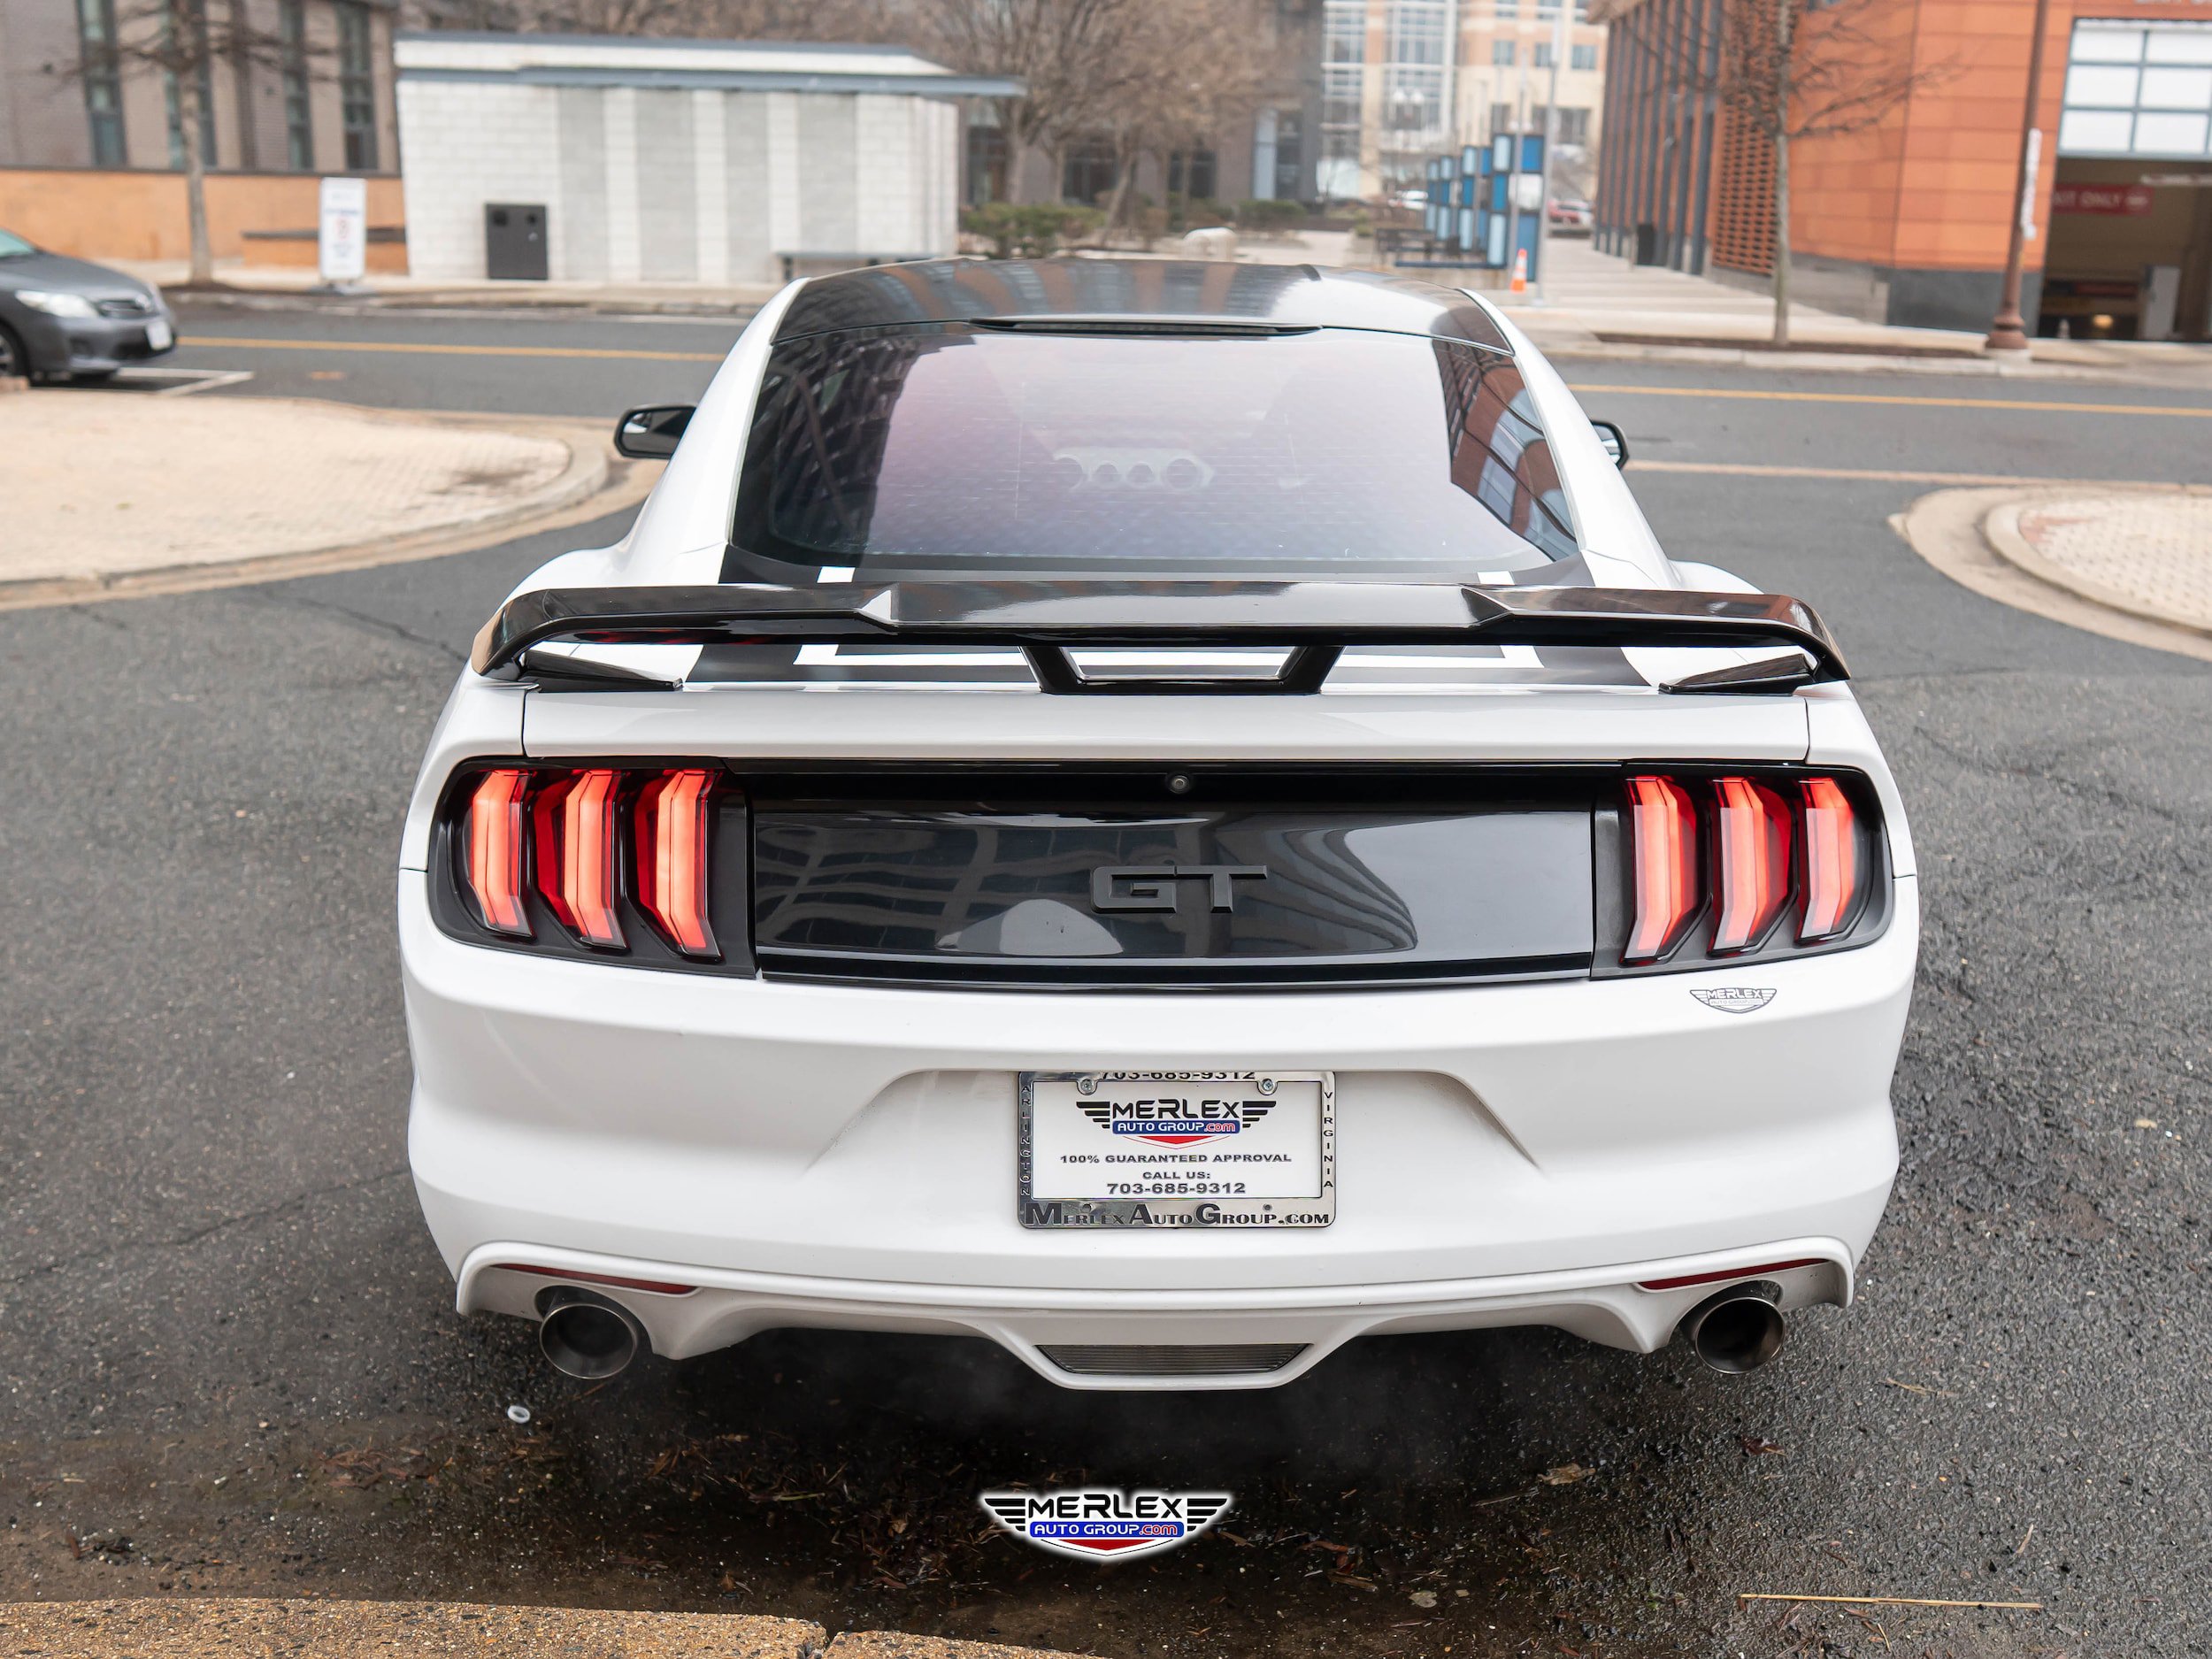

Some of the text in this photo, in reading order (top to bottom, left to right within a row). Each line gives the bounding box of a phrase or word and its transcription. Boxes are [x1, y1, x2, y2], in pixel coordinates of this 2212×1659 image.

[2052, 190, 2076, 206] XIT
[1090, 865, 1268, 914] GT
[1707, 988, 1762, 999] MERLEX
[1112, 1098, 1240, 1119] MERLEX
[1117, 1122, 1236, 1133] AUTO GROUP.com
[1019, 1086, 1032, 1197] ARLINGTON
[1323, 1091, 1334, 1188] VIRGINIA
[1060, 1154, 1293, 1164] 100% GUARANTEED APPROVAL
[1142, 1171, 1212, 1180] CALL US:
[1106, 1182, 1247, 1195] 703-685-9312
